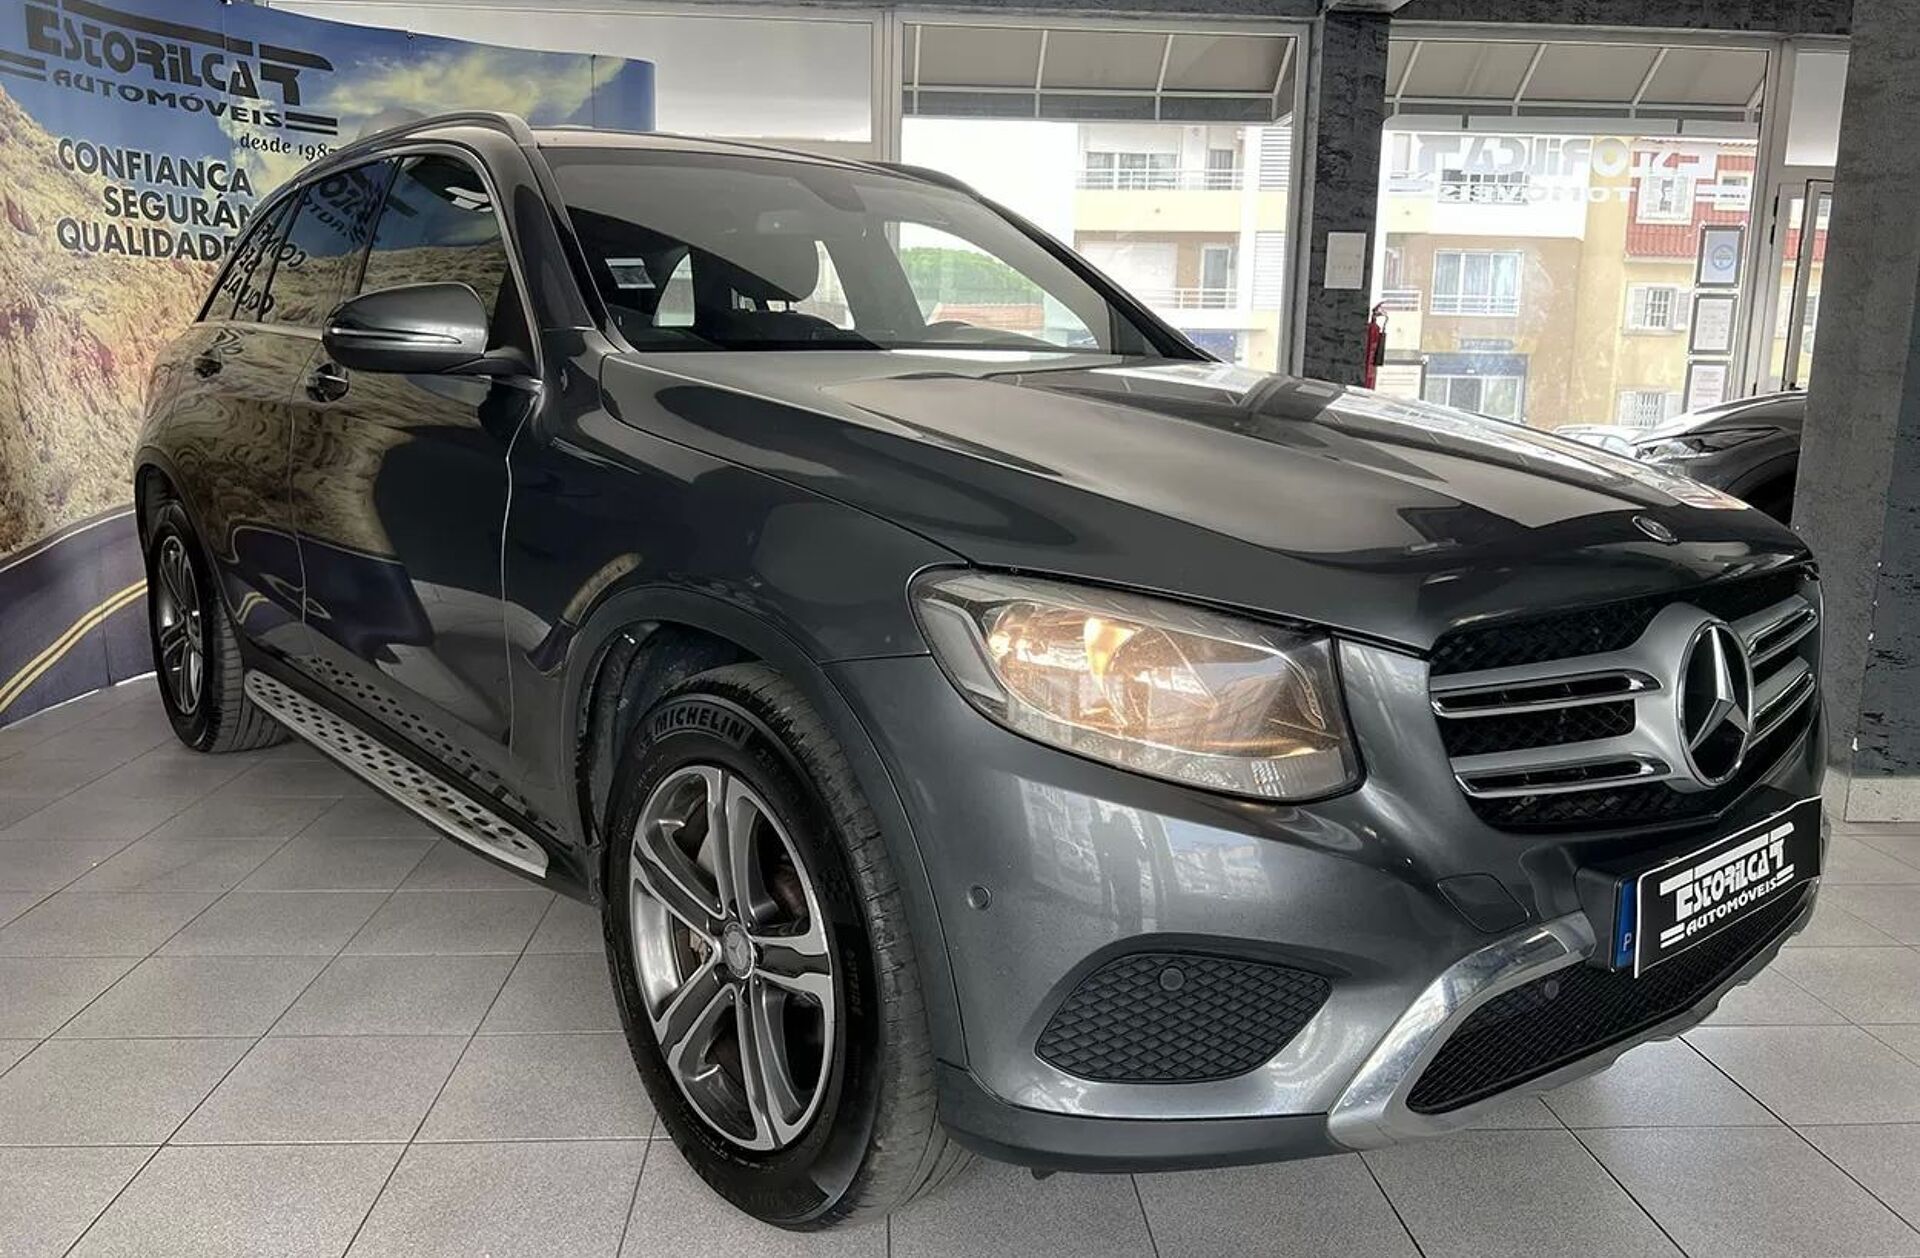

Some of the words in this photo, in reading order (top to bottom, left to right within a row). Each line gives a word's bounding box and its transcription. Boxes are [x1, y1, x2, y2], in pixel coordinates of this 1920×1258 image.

[52, 68, 283, 129] AUTOMÓVEIS
[240, 133, 292, 154] desde
[58, 138, 253, 199] CONFIANÇA
[655, 706, 747, 741] MICHELIN
[1686, 877, 1777, 936] AUTOMÓVEIS
[1623, 932, 1632, 951] P
